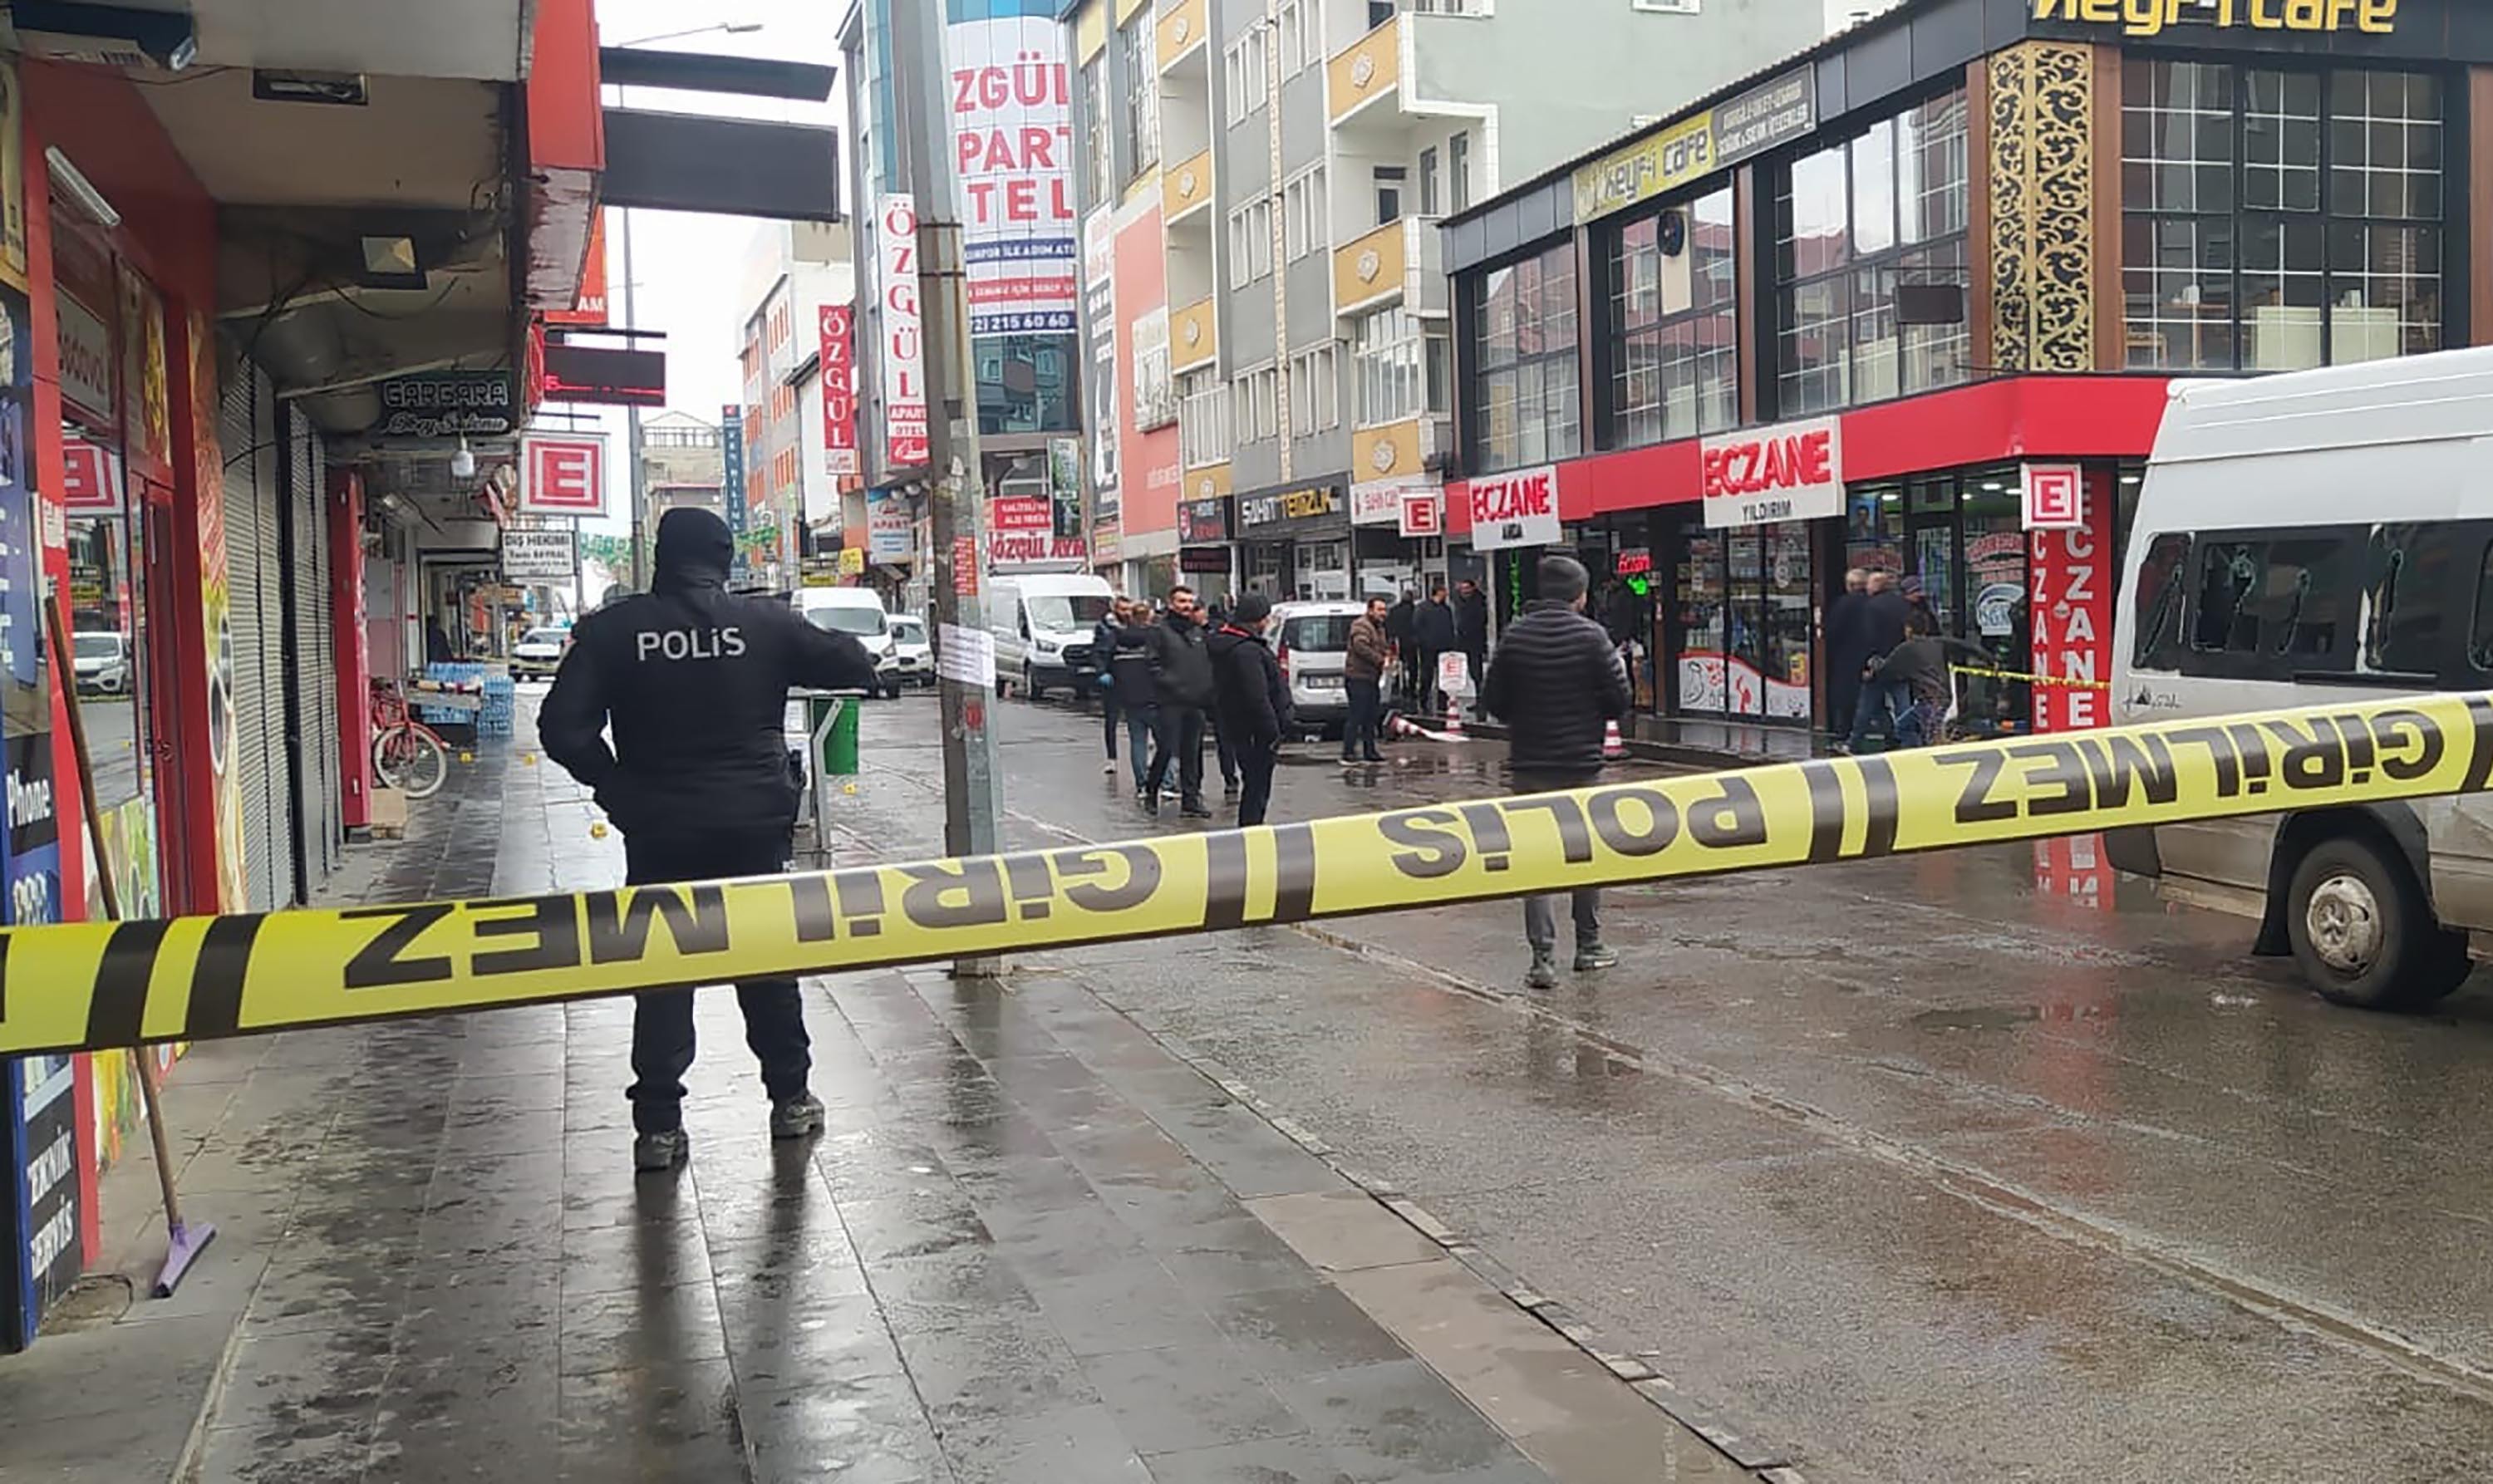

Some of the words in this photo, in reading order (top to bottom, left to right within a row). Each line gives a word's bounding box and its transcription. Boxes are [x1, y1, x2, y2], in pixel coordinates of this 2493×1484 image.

[991, 316, 1020, 330] 215
[1023, 315, 1045, 328] 60
[1048, 314, 1069, 327] 60
[822, 311, 848, 448] ÖZGÜL
[1704, 430, 1832, 498] ECZANE
[1412, 503, 1432, 527] E
[1473, 474, 1551, 523] ECZANE
[2042, 480, 2065, 514] E
